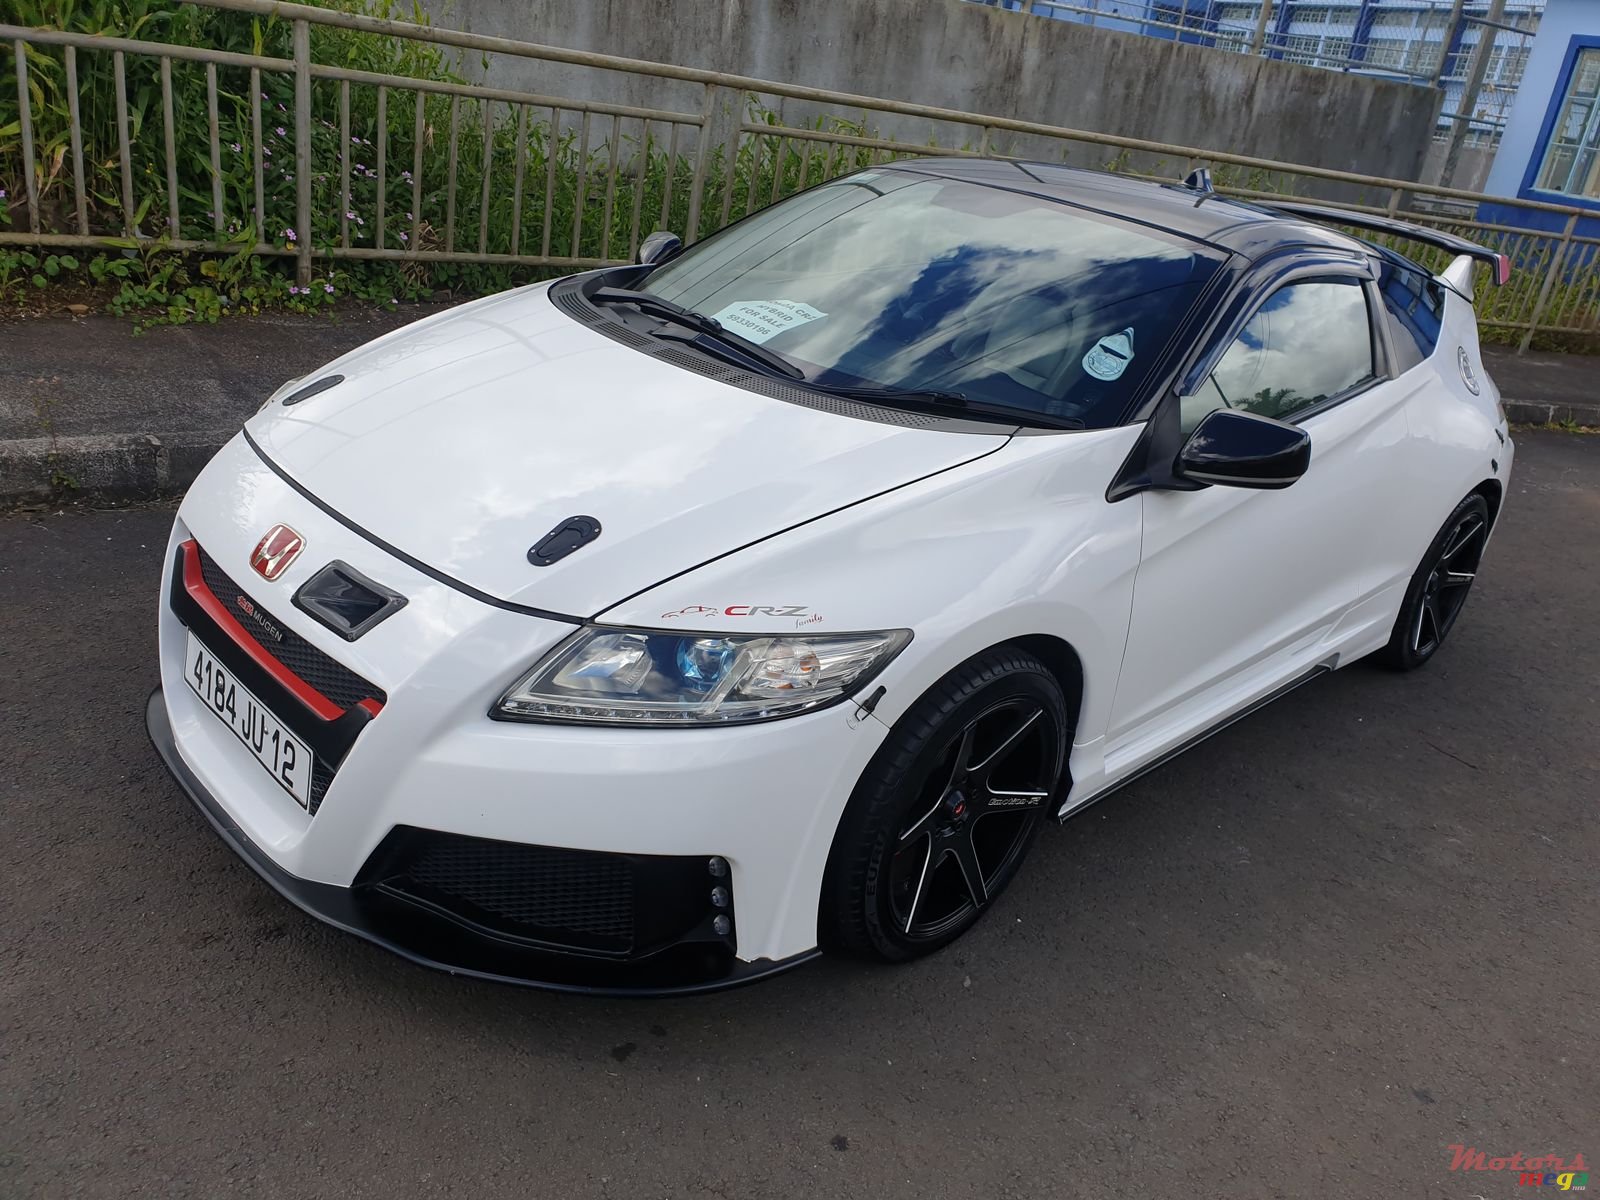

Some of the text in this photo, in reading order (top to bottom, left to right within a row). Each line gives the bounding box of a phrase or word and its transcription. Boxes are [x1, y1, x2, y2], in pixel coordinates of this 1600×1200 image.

[739, 306, 785, 329] FOR SALE
[253, 610, 283, 642] MUGEN
[194, 649, 297, 789] 4184 JU 12
